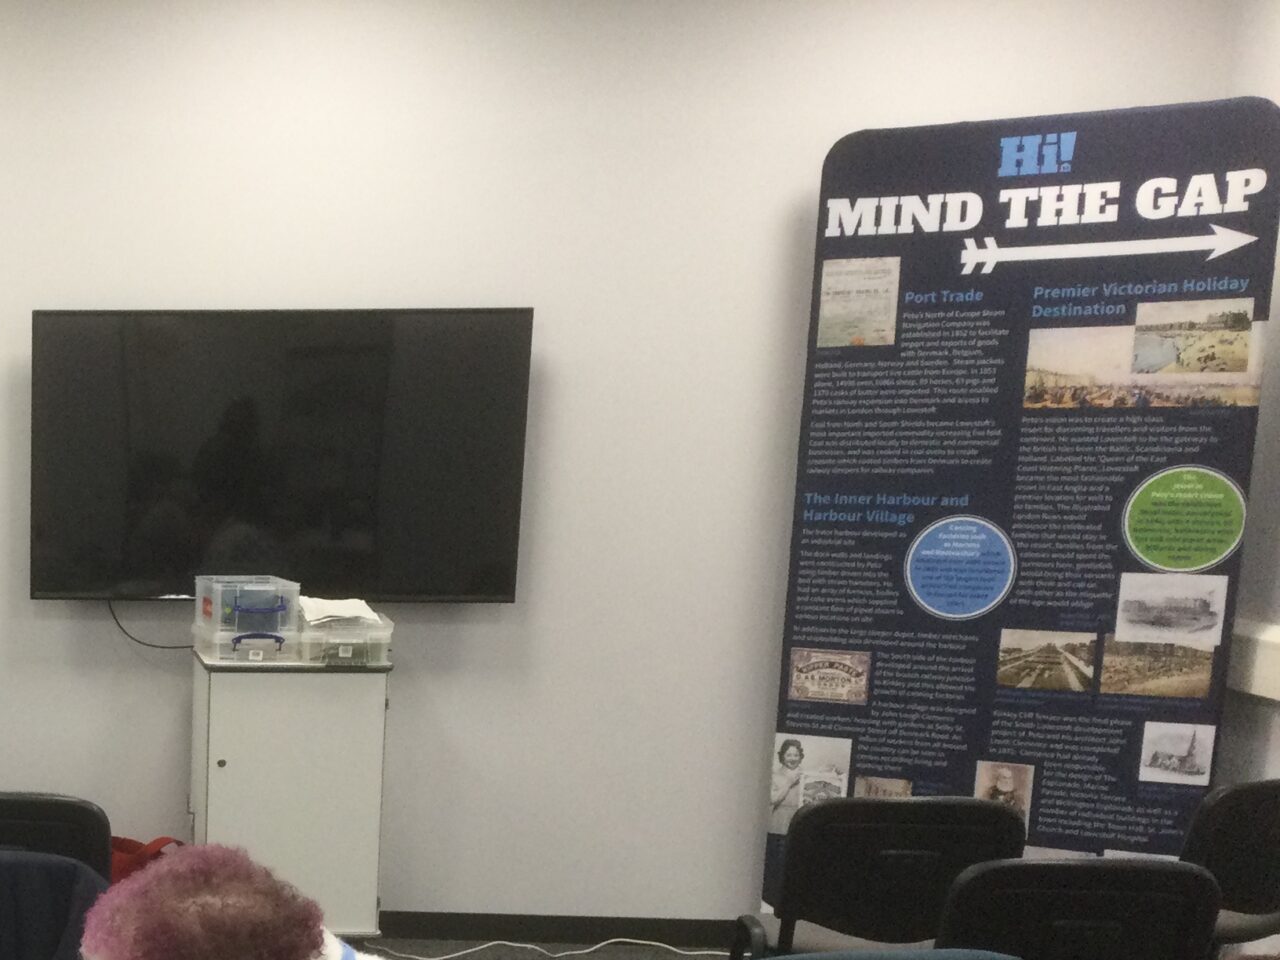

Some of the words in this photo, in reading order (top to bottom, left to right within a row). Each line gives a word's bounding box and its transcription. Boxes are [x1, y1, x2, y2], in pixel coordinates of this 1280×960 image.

[998, 131, 1076, 178] Hi!
[825, 191, 984, 237] MIND
[999, 181, 1121, 228] THE
[1135, 168, 1268, 220] GAP
[1033, 284, 1098, 300] Premier
[1103, 281, 1178, 297] Victorian
[1183, 277, 1250, 293] Holiday
[905, 292, 936, 304] Port
[942, 290, 984, 302] Trade
[1032, 302, 1126, 318] Destination
[804, 492, 832, 504] The
[834, 493, 872, 504] Inner
[876, 494, 934, 506] Harbour
[941, 494, 968, 507] and
[803, 510, 862, 521] Harbour
[866, 510, 914, 525] Village
